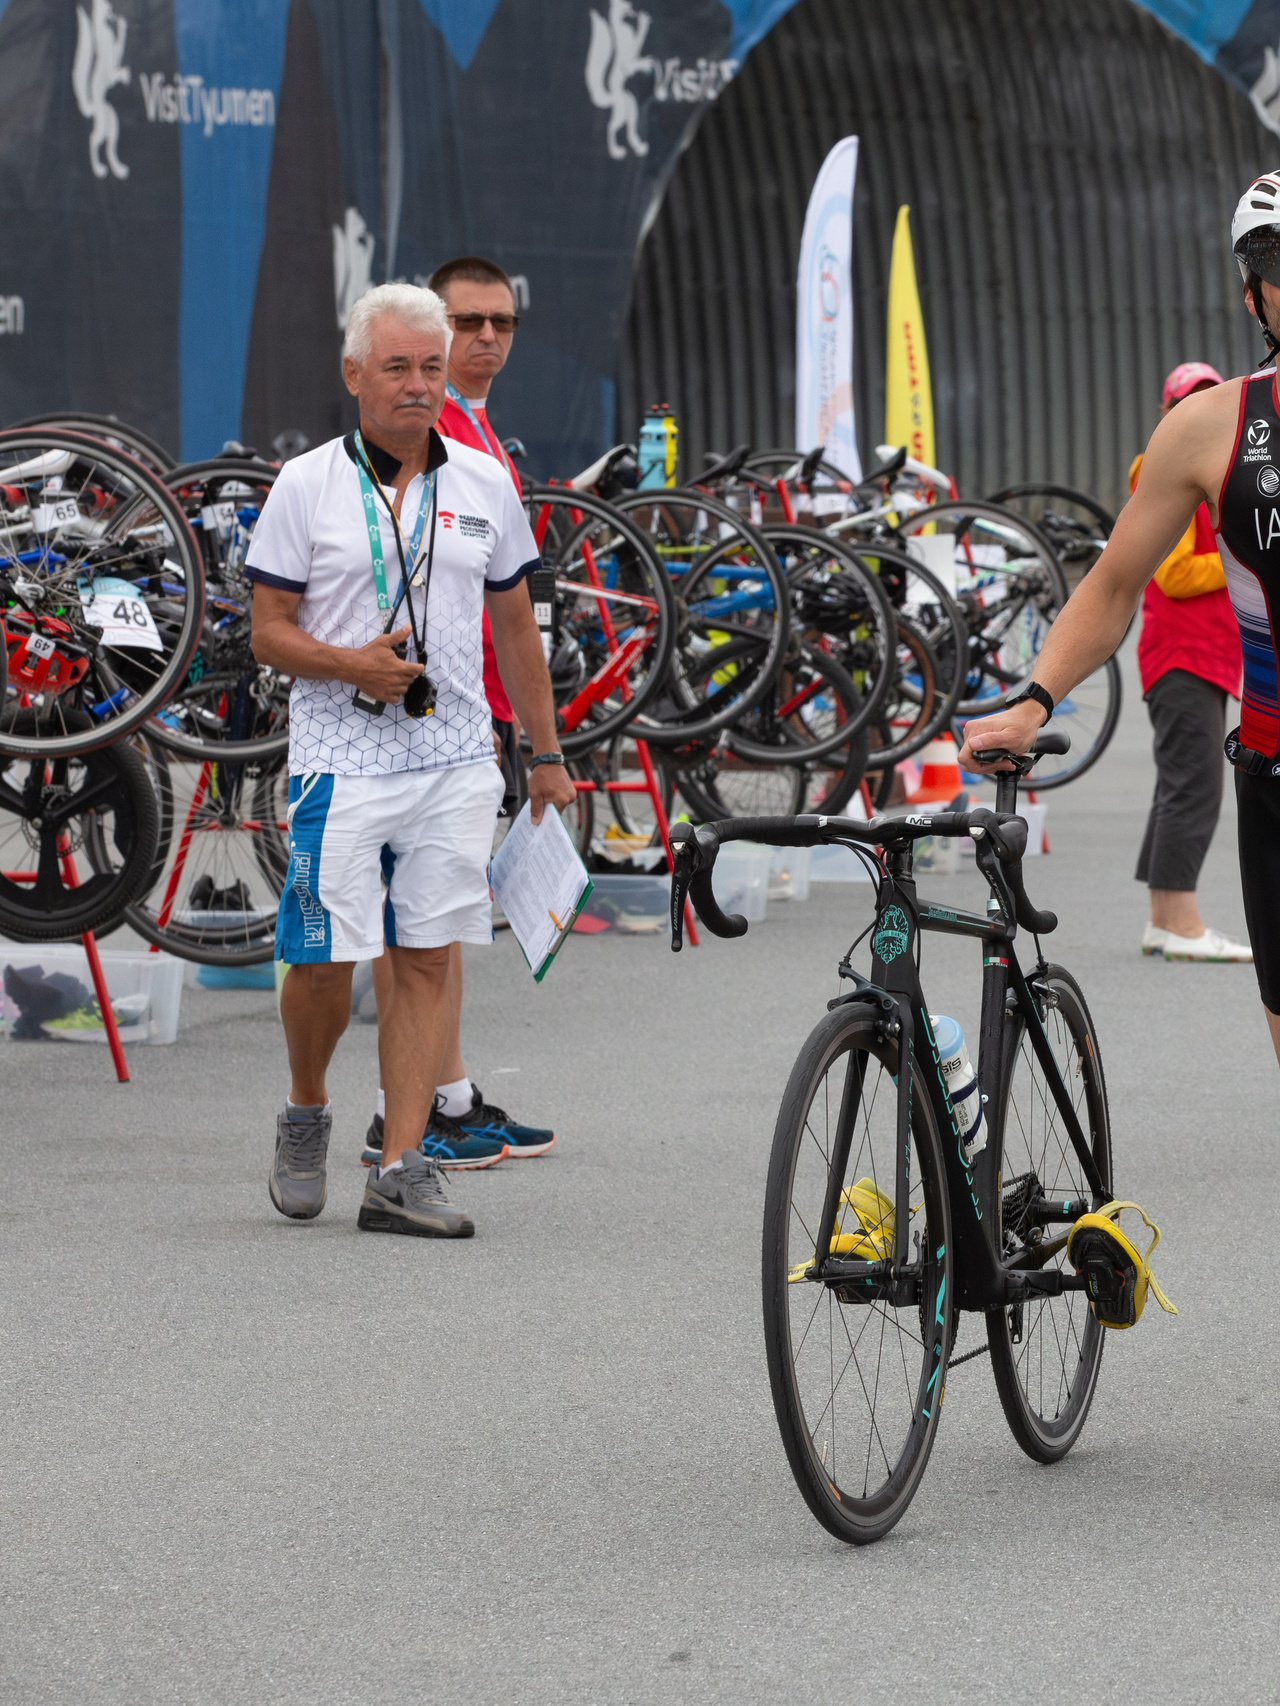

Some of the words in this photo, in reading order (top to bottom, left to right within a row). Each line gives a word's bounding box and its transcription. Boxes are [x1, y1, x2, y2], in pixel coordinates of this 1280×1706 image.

[139, 71, 276, 137] VisitTyumen
[1243, 454, 1272, 462] Triathlon
[1248, 447, 1268, 455] World
[55, 503, 77, 521] 65
[112, 599, 148, 627] 48
[537, 607, 549, 617] 11
[34, 638, 50, 651] 49
[293, 852, 325, 947] RUSSIA
[673, 884, 681, 931] ULTEGRA
